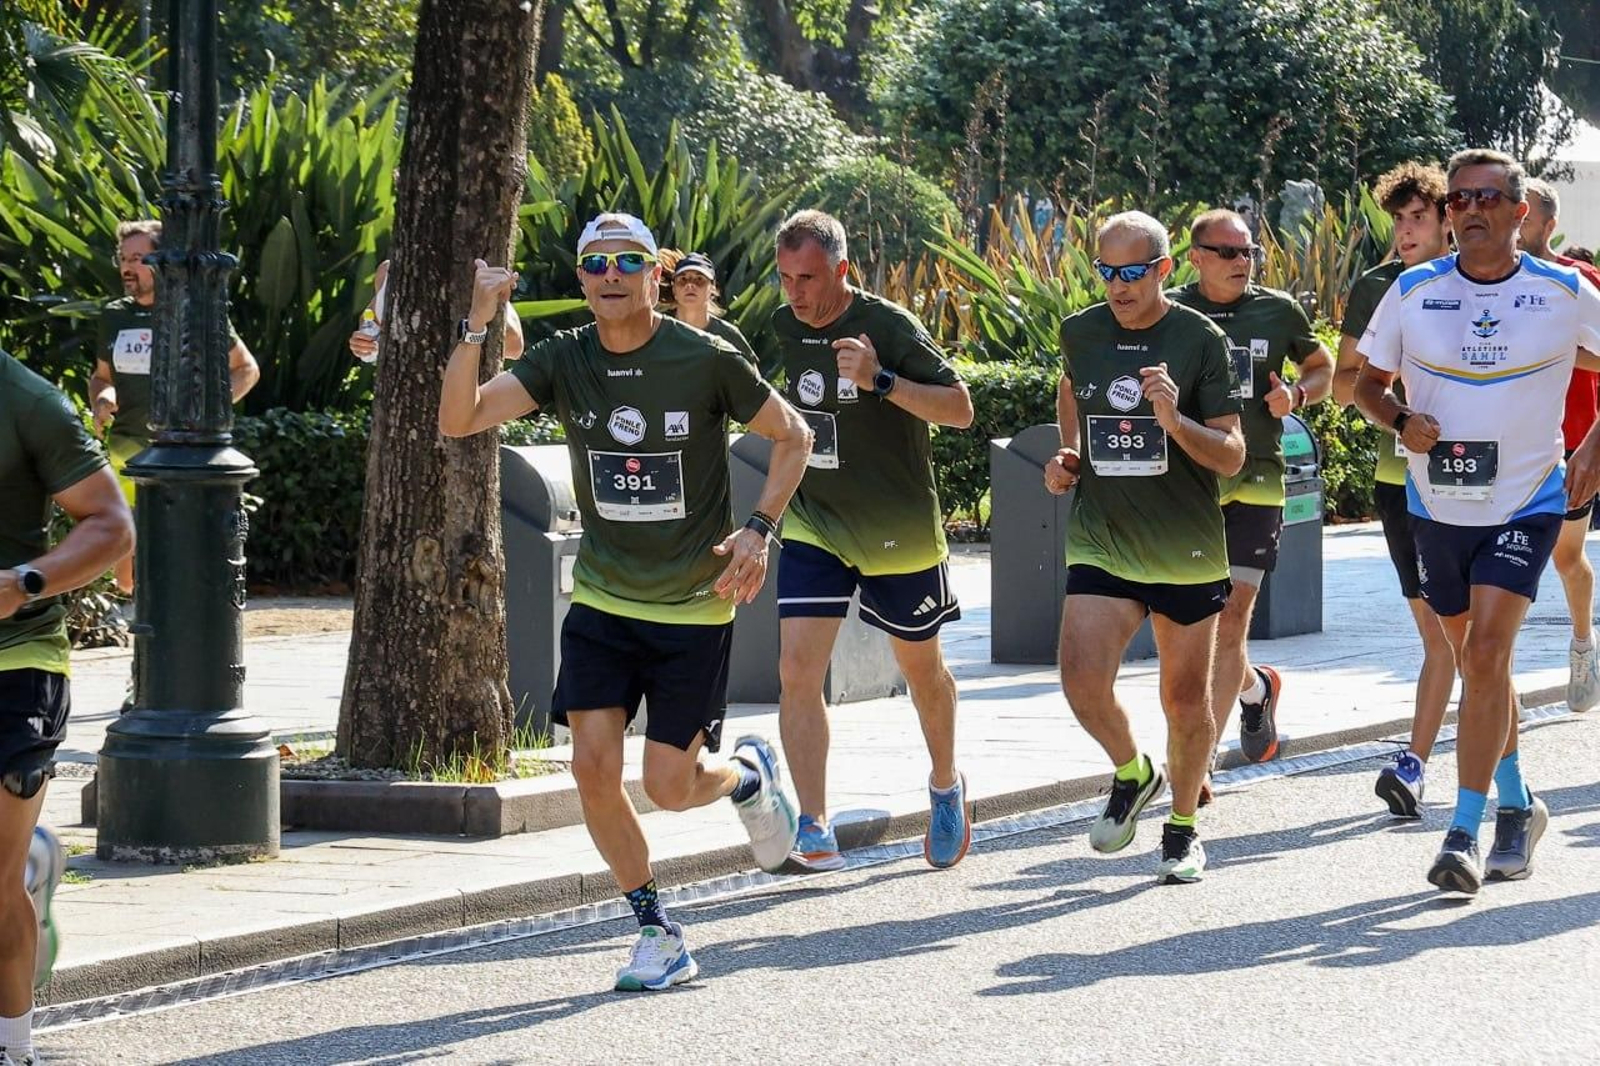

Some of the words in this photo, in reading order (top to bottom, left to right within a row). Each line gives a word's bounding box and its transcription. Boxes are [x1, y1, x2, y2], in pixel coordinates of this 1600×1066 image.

[1462, 352, 1506, 361] SAMIL
[1111, 389, 1135, 404] FRENO
[1114, 383, 1138, 397] PONLE
[613, 421, 640, 437] FRENO
[615, 415, 641, 430] PONLE
[1107, 434, 1145, 449] 393
[1442, 458, 1477, 473] 193
[613, 474, 656, 491] 391
